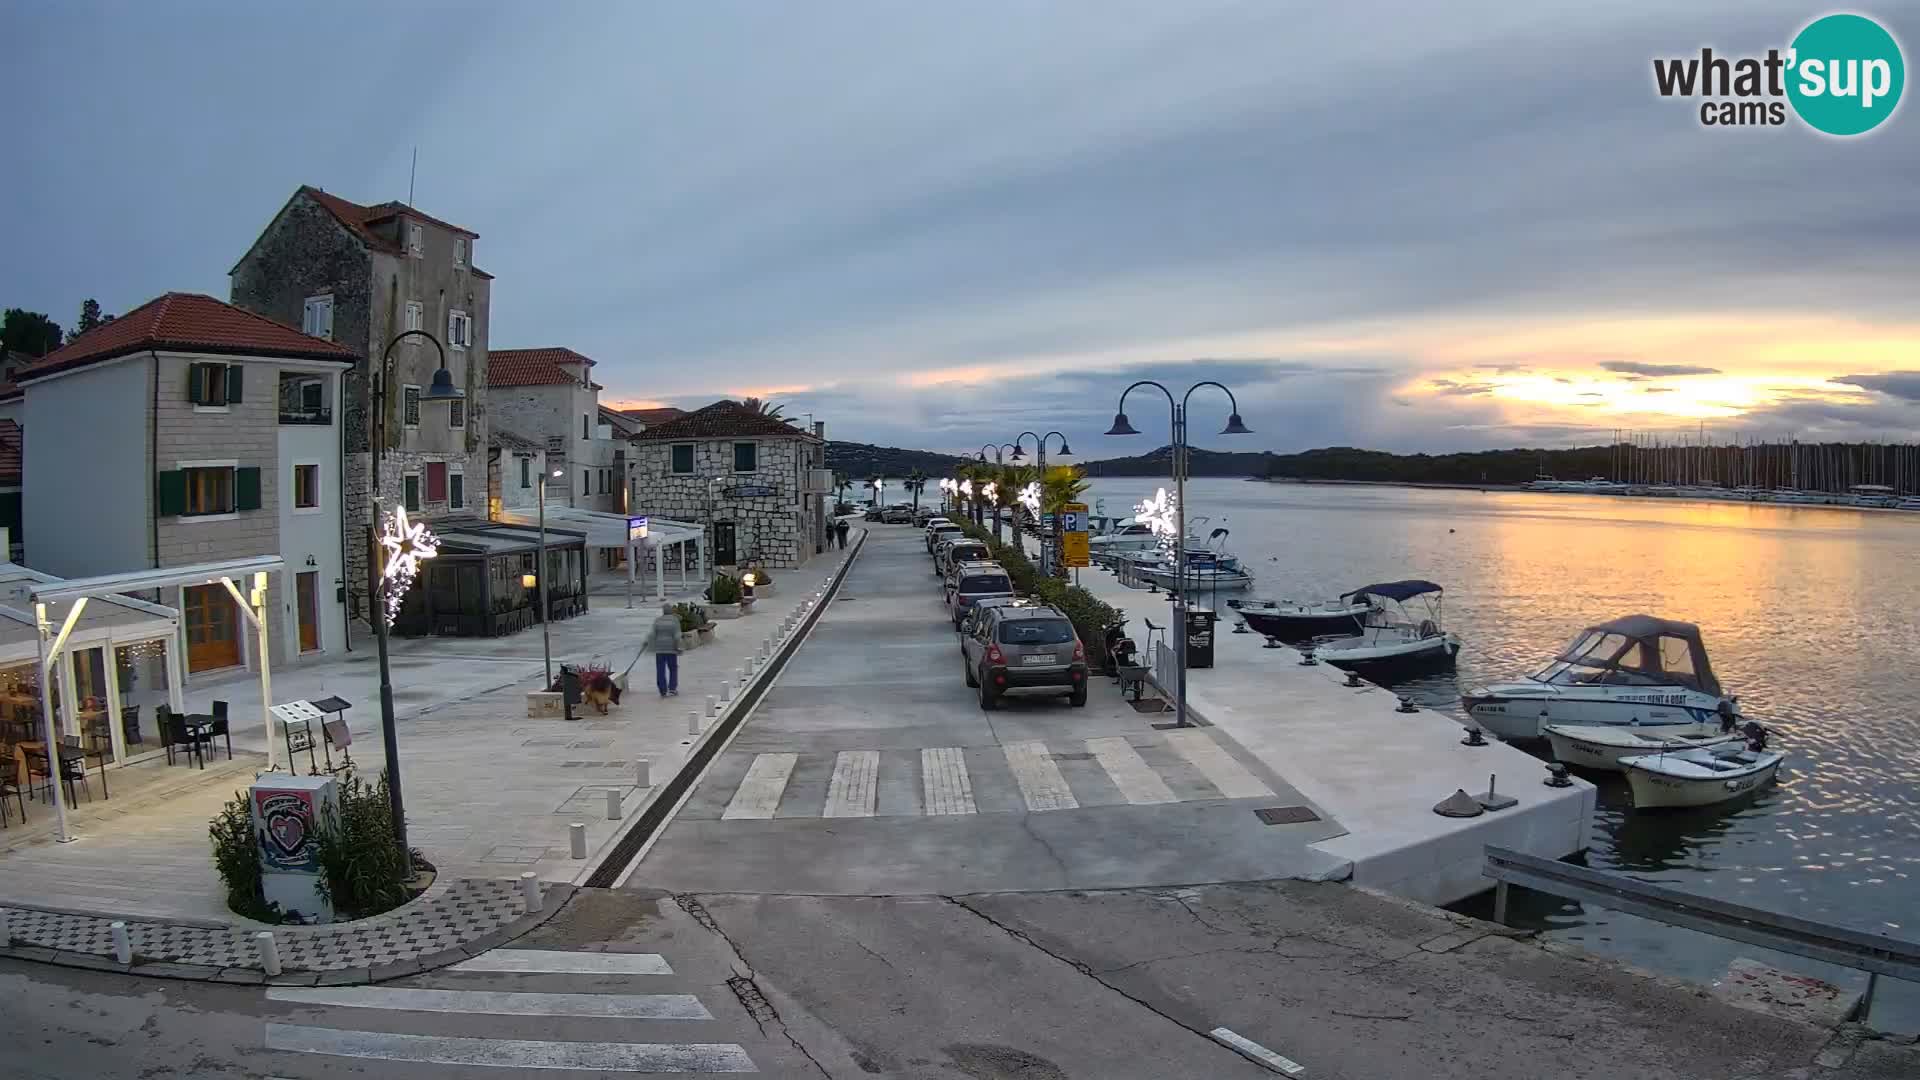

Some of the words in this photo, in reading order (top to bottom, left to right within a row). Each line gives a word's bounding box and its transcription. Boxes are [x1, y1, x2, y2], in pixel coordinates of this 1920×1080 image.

[1064, 514, 1076, 530] P
[1647, 694, 1664, 705] RENT
[1670, 694, 1687, 705] BOAT
